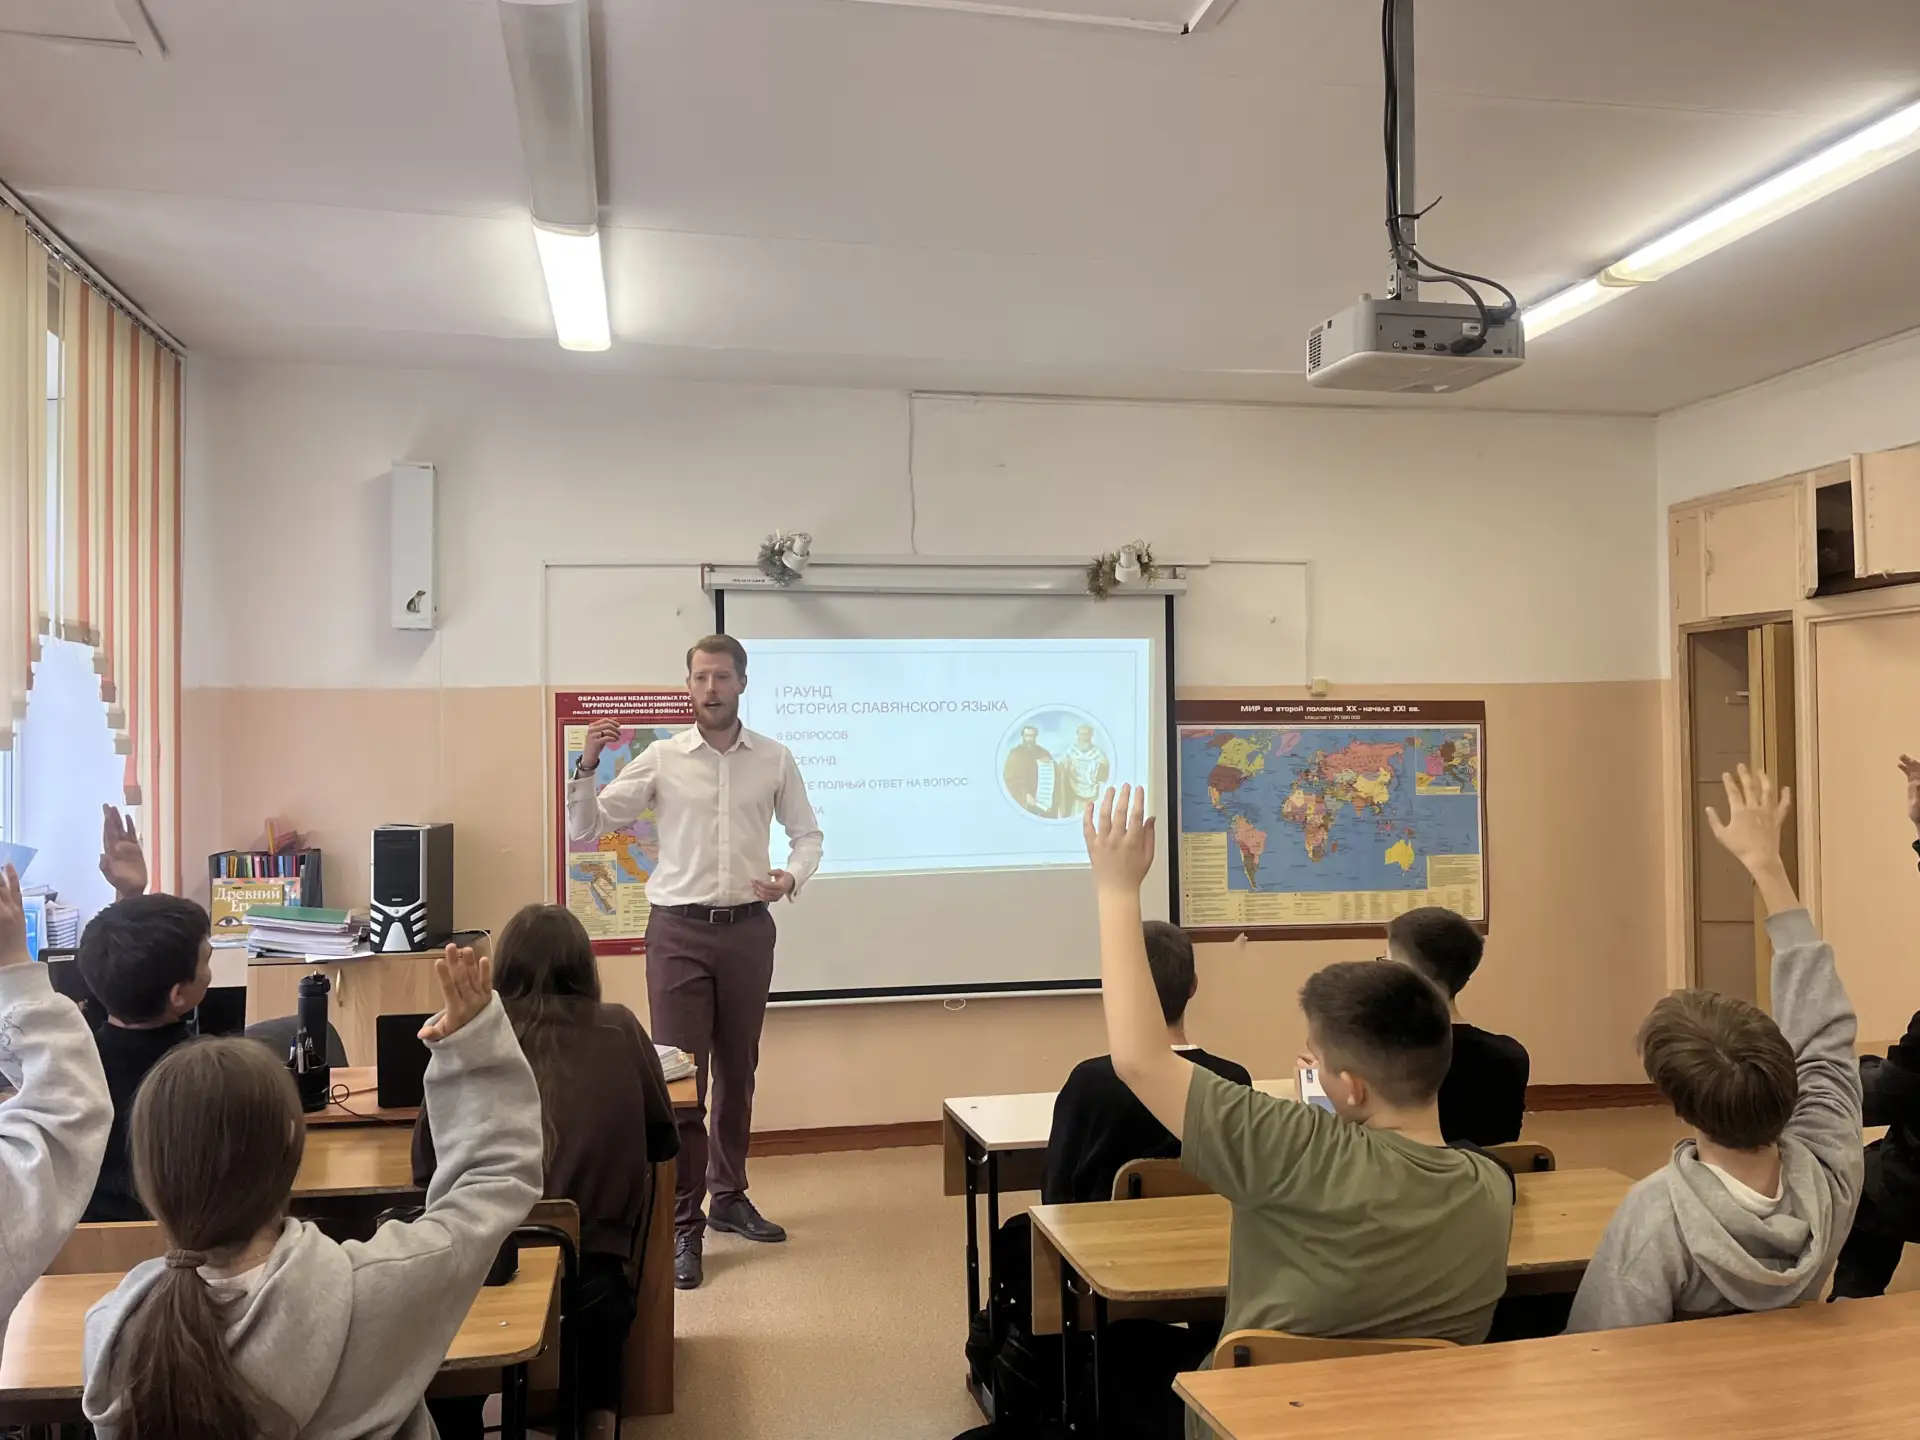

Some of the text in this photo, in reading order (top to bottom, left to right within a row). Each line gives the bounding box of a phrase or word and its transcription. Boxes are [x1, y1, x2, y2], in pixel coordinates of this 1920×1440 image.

[783, 685, 832, 699] РАУНД
[776, 700, 1009, 715] ИСТОРИЯ СЛАВЯНСКОГО ЯЗЫКА
[1275, 705, 1304, 714] второй
[786, 730, 848, 741] ВОПРОСОВ
[818, 780, 866, 791] ПОЛНЫЙ
[868, 779, 903, 789] ОТВЕТ
[907, 778, 921, 788] НА
[923, 777, 969, 788] ВОПРОС
[214, 887, 280, 902] Древний
